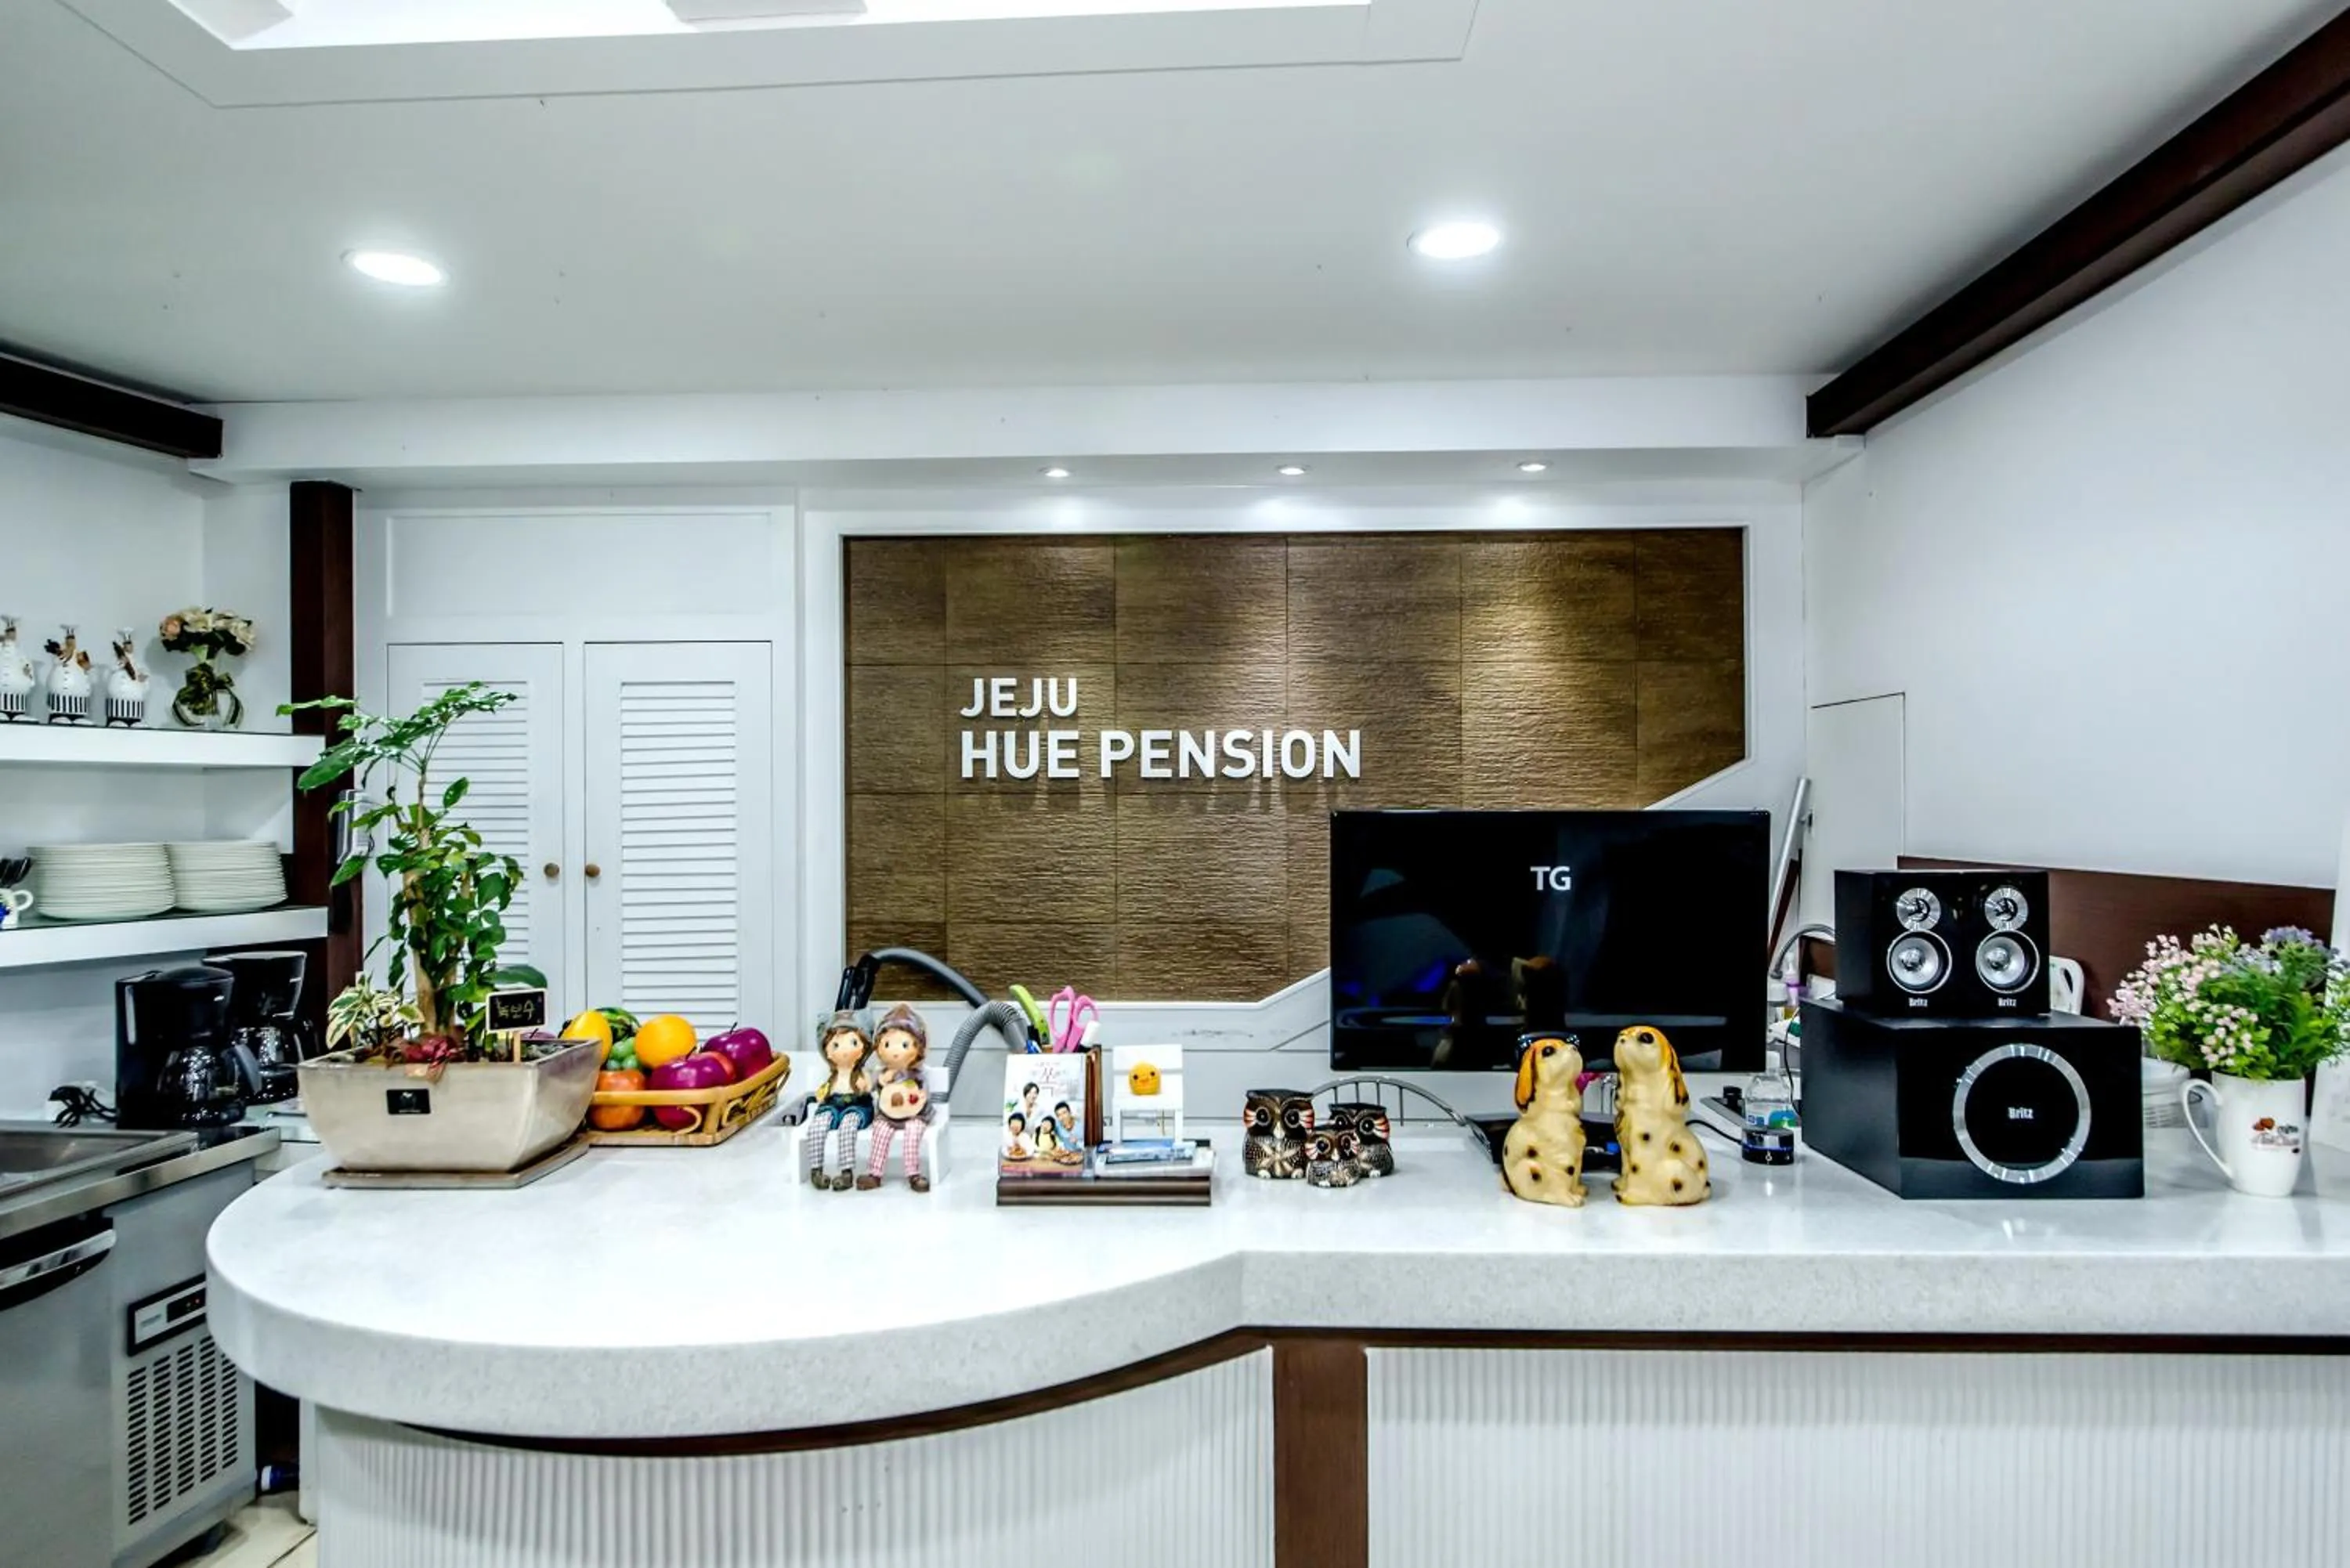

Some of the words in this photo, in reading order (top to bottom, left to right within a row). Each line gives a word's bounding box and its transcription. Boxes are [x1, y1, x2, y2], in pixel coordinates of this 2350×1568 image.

[960, 677, 1077, 717] JEJU
[960, 730, 1080, 779] HUE
[1100, 729, 1361, 779] PENSION
[1530, 865, 1571, 891] TG
[2008, 1107, 2034, 1120] Britz
